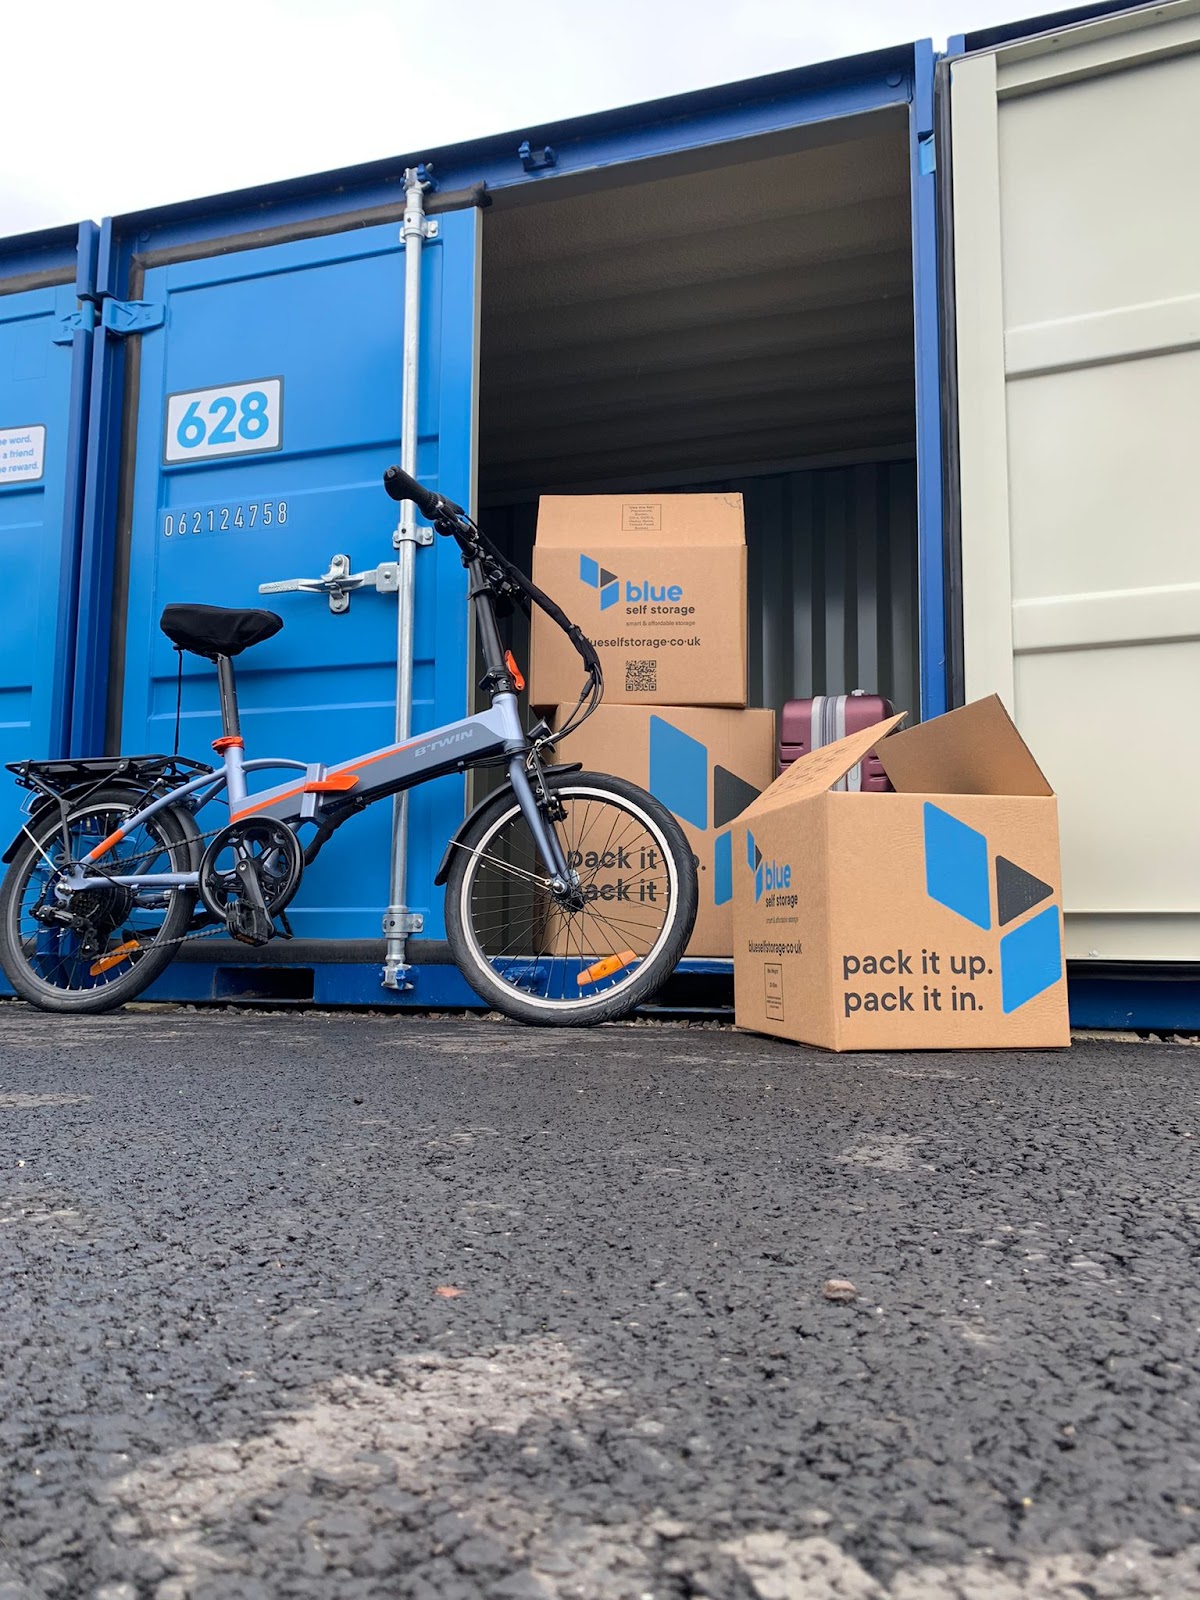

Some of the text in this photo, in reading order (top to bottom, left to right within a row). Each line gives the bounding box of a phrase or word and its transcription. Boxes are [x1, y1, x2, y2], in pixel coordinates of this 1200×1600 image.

[176, 391, 269, 448] 628
[10, 435, 31, 444] word.
[10, 448, 34, 458] friend
[9, 461, 39, 472] reward.
[164, 502, 287, 536] 062124758
[626, 580, 683, 602] blue
[626, 605, 695, 616] self storage
[567, 847, 631, 869] pack
[640, 847, 657, 869] it
[766, 860, 791, 890] blue
[583, 879, 631, 901] ack
[640, 879, 657, 901] it
[766, 894, 798, 908] self storage
[843, 950, 993, 980] pack it up.
[844, 986, 984, 1017] pack it in.
